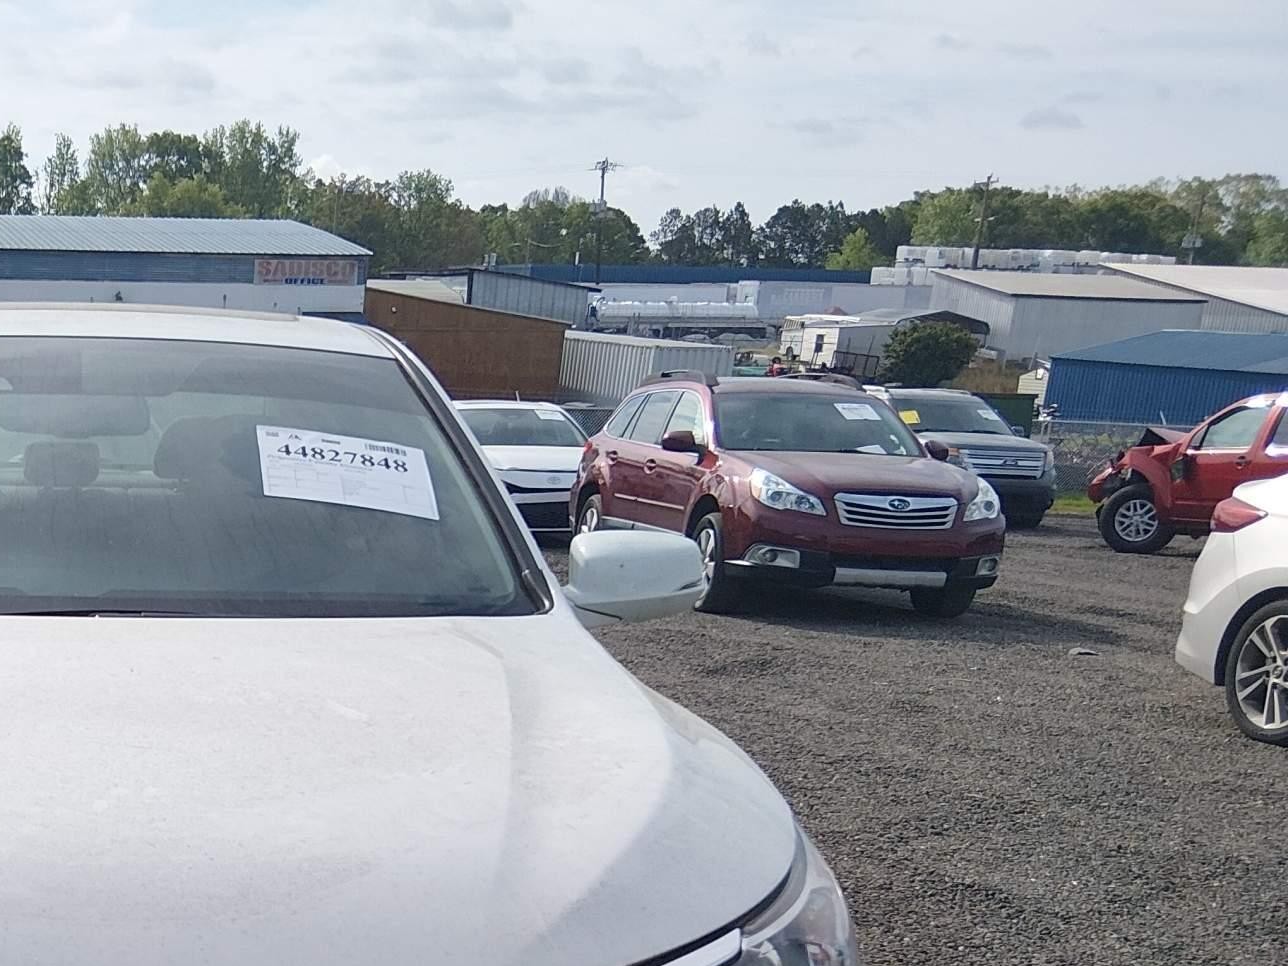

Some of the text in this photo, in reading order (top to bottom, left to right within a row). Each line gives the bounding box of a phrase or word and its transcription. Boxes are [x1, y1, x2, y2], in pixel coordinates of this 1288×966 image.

[257, 259, 355, 277] SADISCO
[284, 277, 328, 285] OFFICE
[277, 443, 408, 473] 44827848
